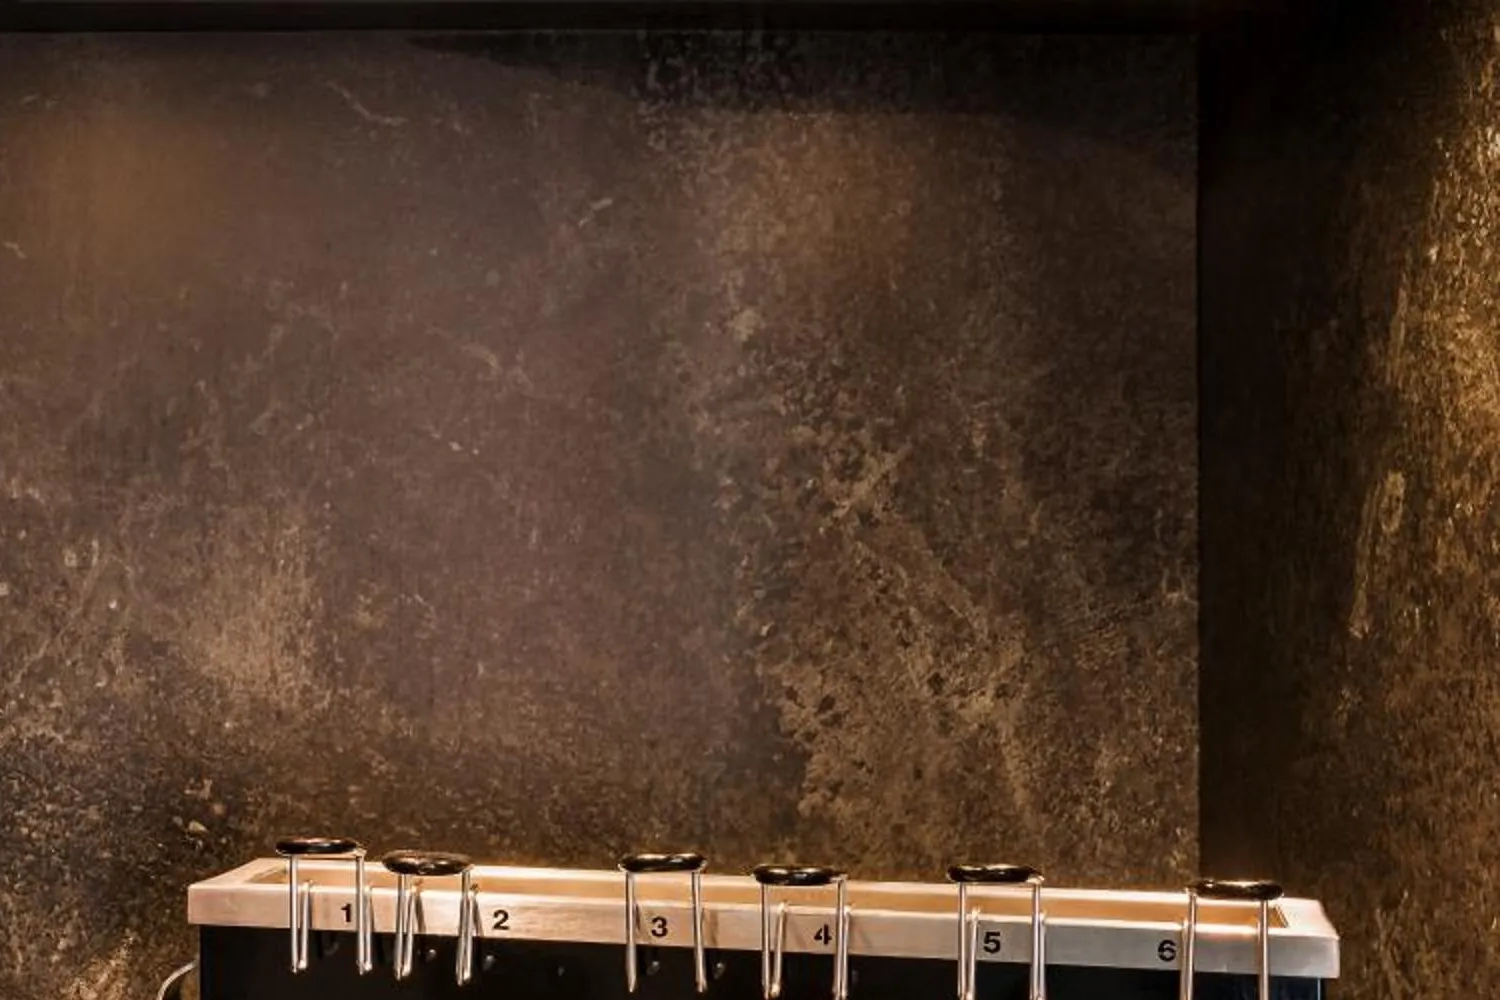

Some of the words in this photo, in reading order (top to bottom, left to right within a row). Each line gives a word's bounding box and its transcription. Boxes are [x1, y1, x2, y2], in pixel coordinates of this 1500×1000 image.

[341, 903, 352, 923] 1
[493, 909, 510, 931] 2
[651, 916, 668, 938] 3
[813, 925, 832, 946] 4
[983, 932, 1002, 954] 5
[1157, 940, 1178, 962] 6
